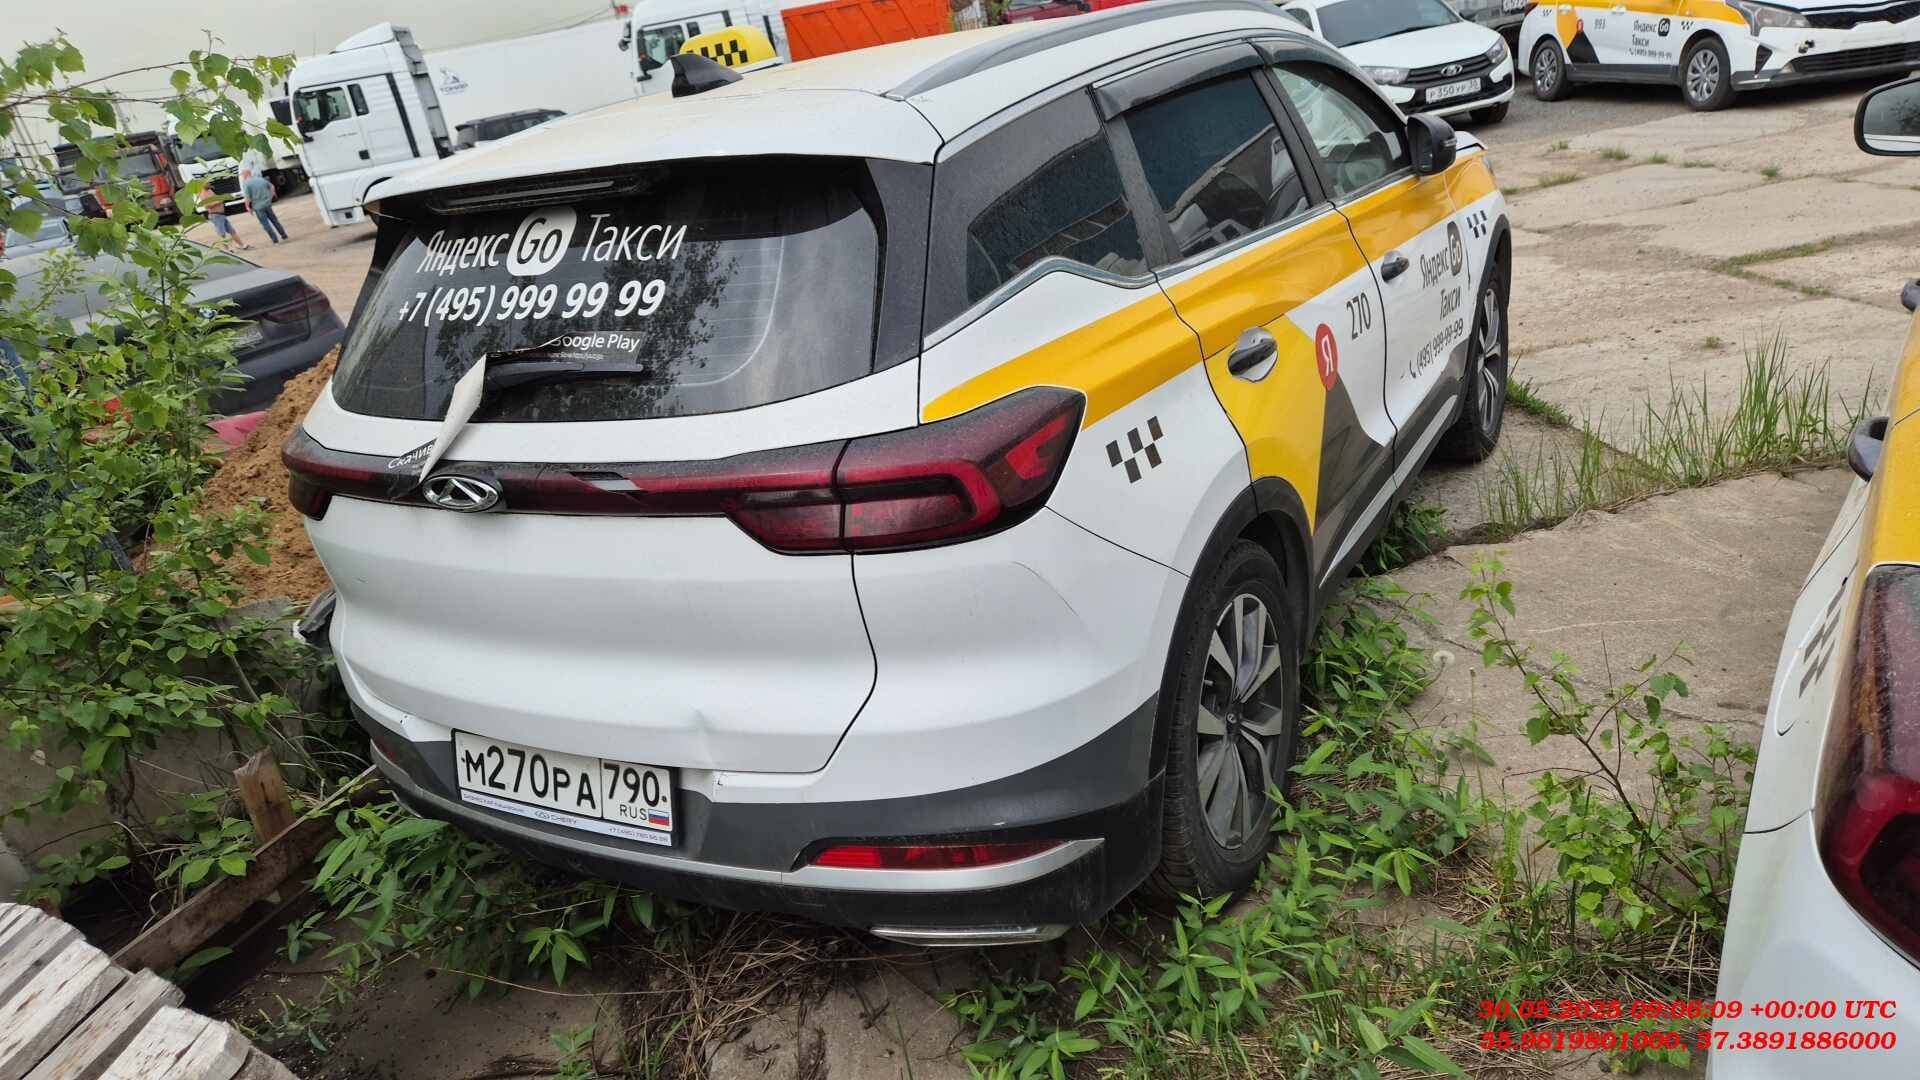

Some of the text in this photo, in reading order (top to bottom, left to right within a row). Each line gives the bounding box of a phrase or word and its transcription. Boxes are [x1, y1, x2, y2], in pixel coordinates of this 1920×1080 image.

[1632, 34, 1650, 46] Такси
[416, 213, 688, 277] Яндекс Go Такси
[1420, 247, 1449, 290] Яндекс
[399, 279, 666, 327] +7 (495) 999 99 99
[1346, 292, 1371, 341] 270
[1440, 286, 1461, 321] Такси
[607, 333, 641, 352] Play
[1321, 334, 1334, 377] Я
[465, 745, 660, 811] М270РА 790
[619, 804, 648, 822] RUS
